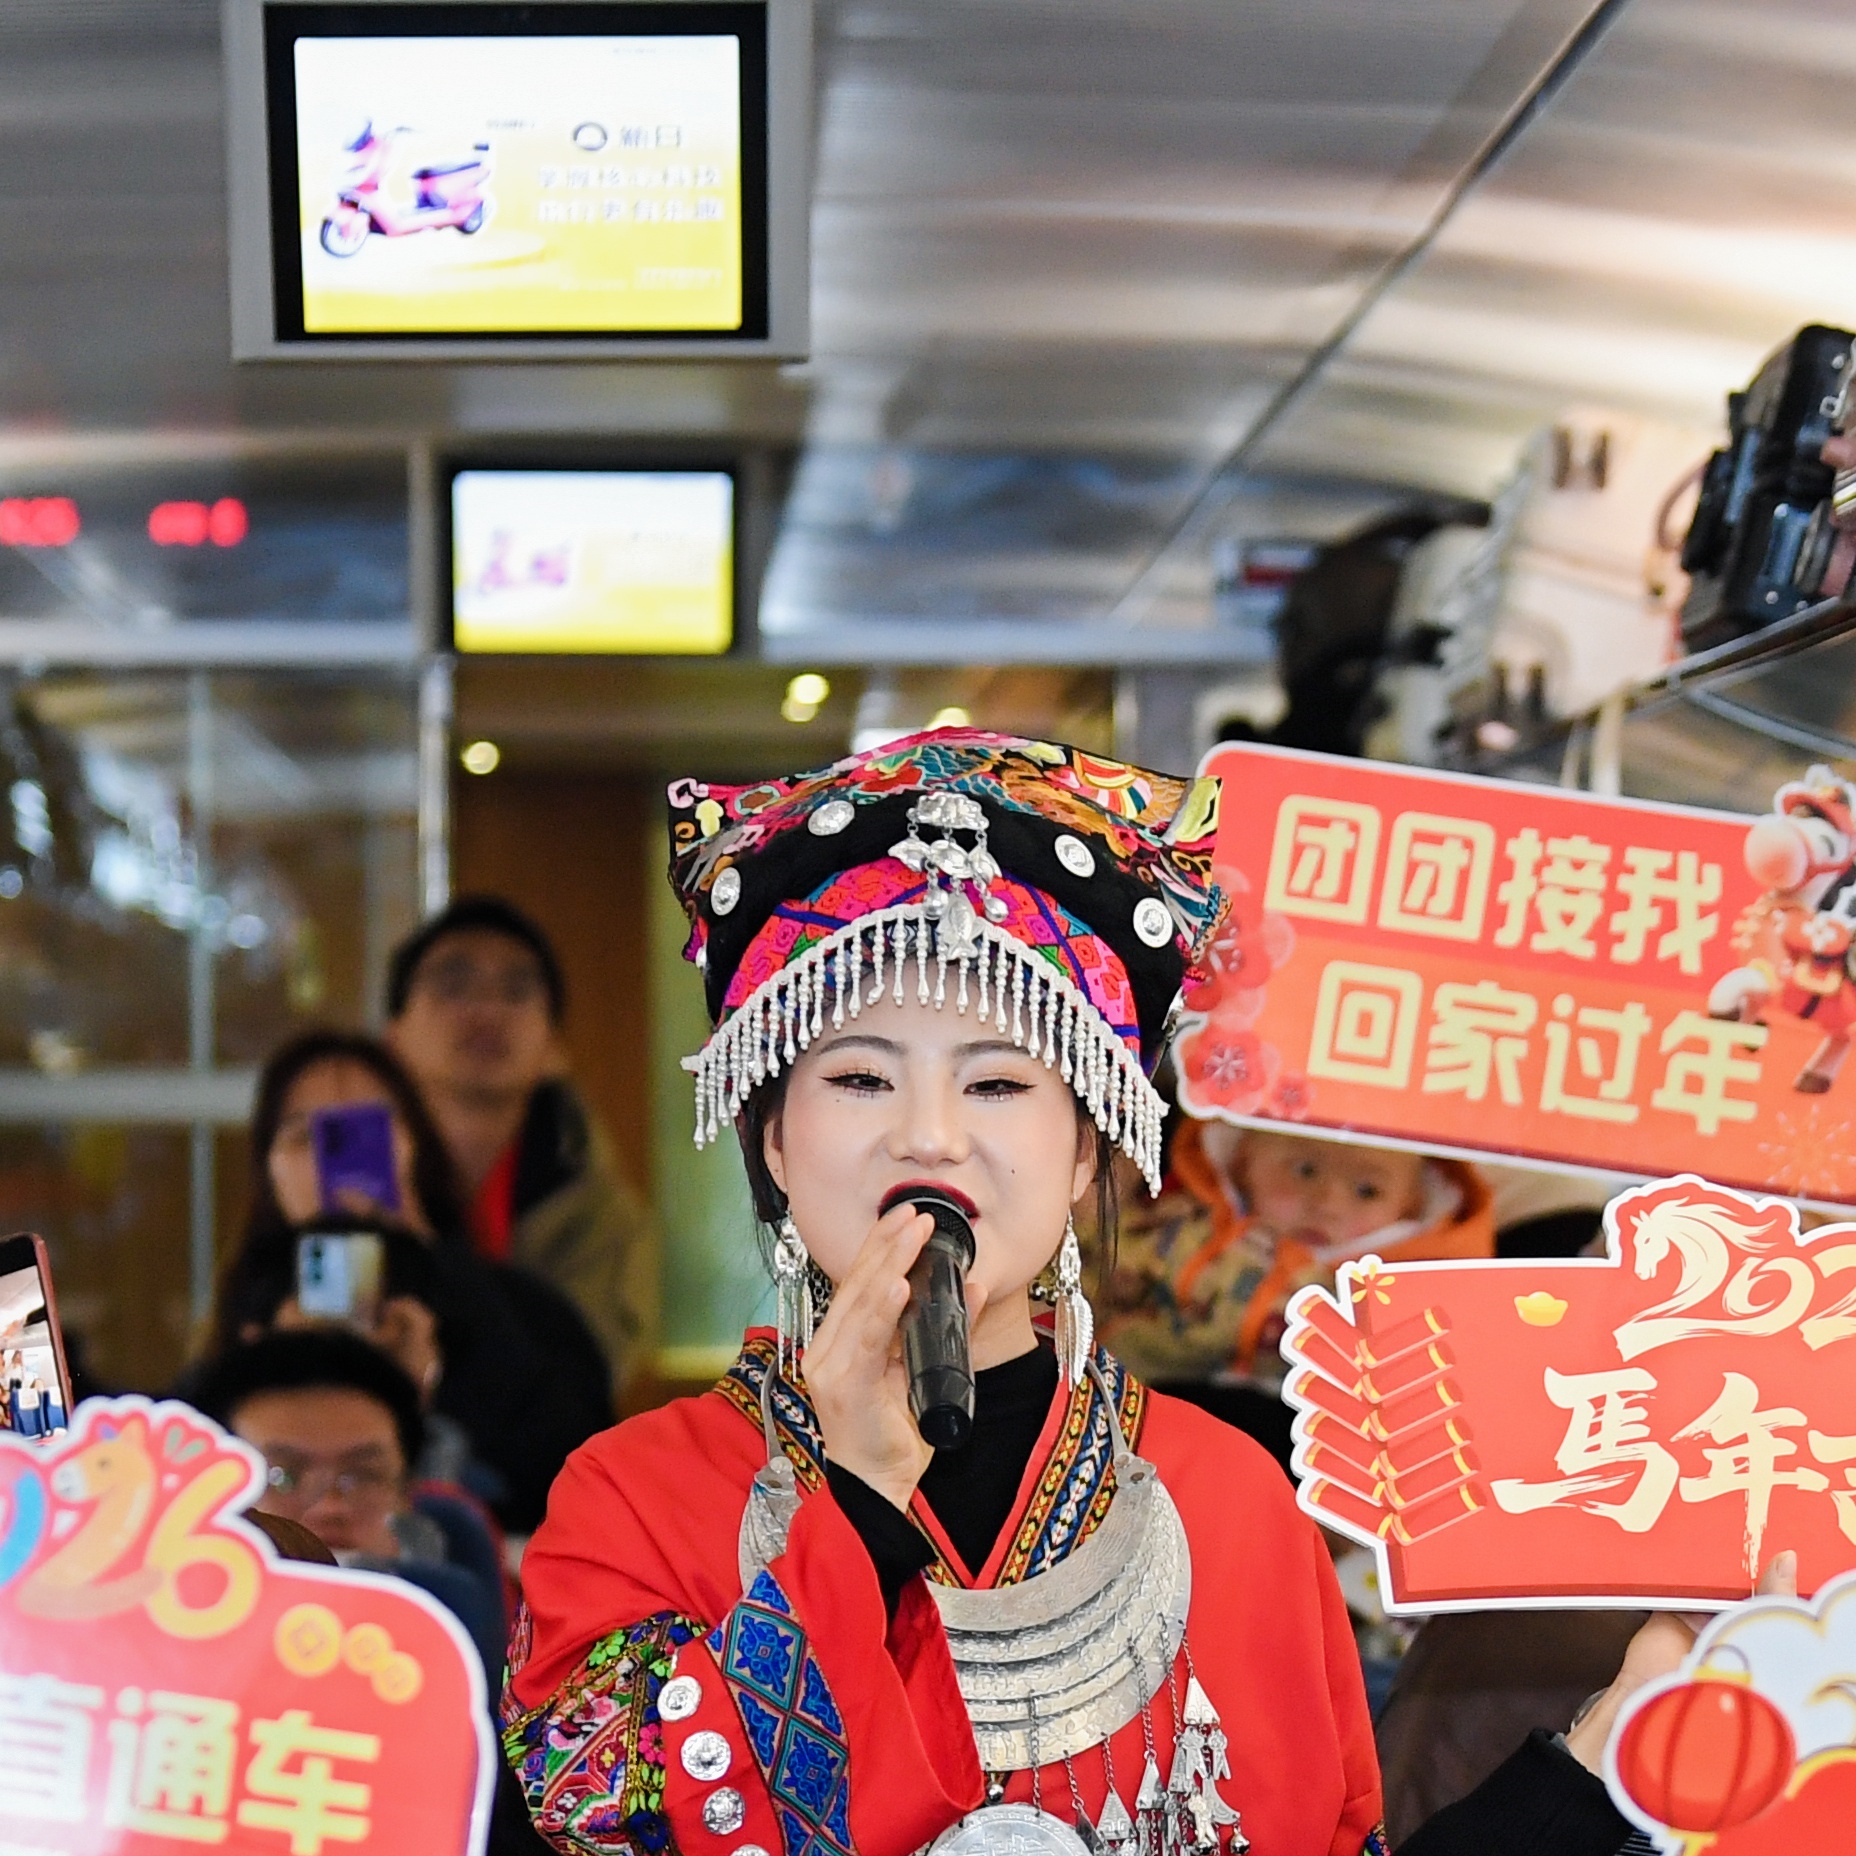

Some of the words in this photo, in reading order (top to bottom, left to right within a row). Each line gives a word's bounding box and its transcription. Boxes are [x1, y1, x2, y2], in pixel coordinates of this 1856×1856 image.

[1263, 794, 1724, 975] 团团接我
[1306, 960, 1769, 1136] 回家过年
